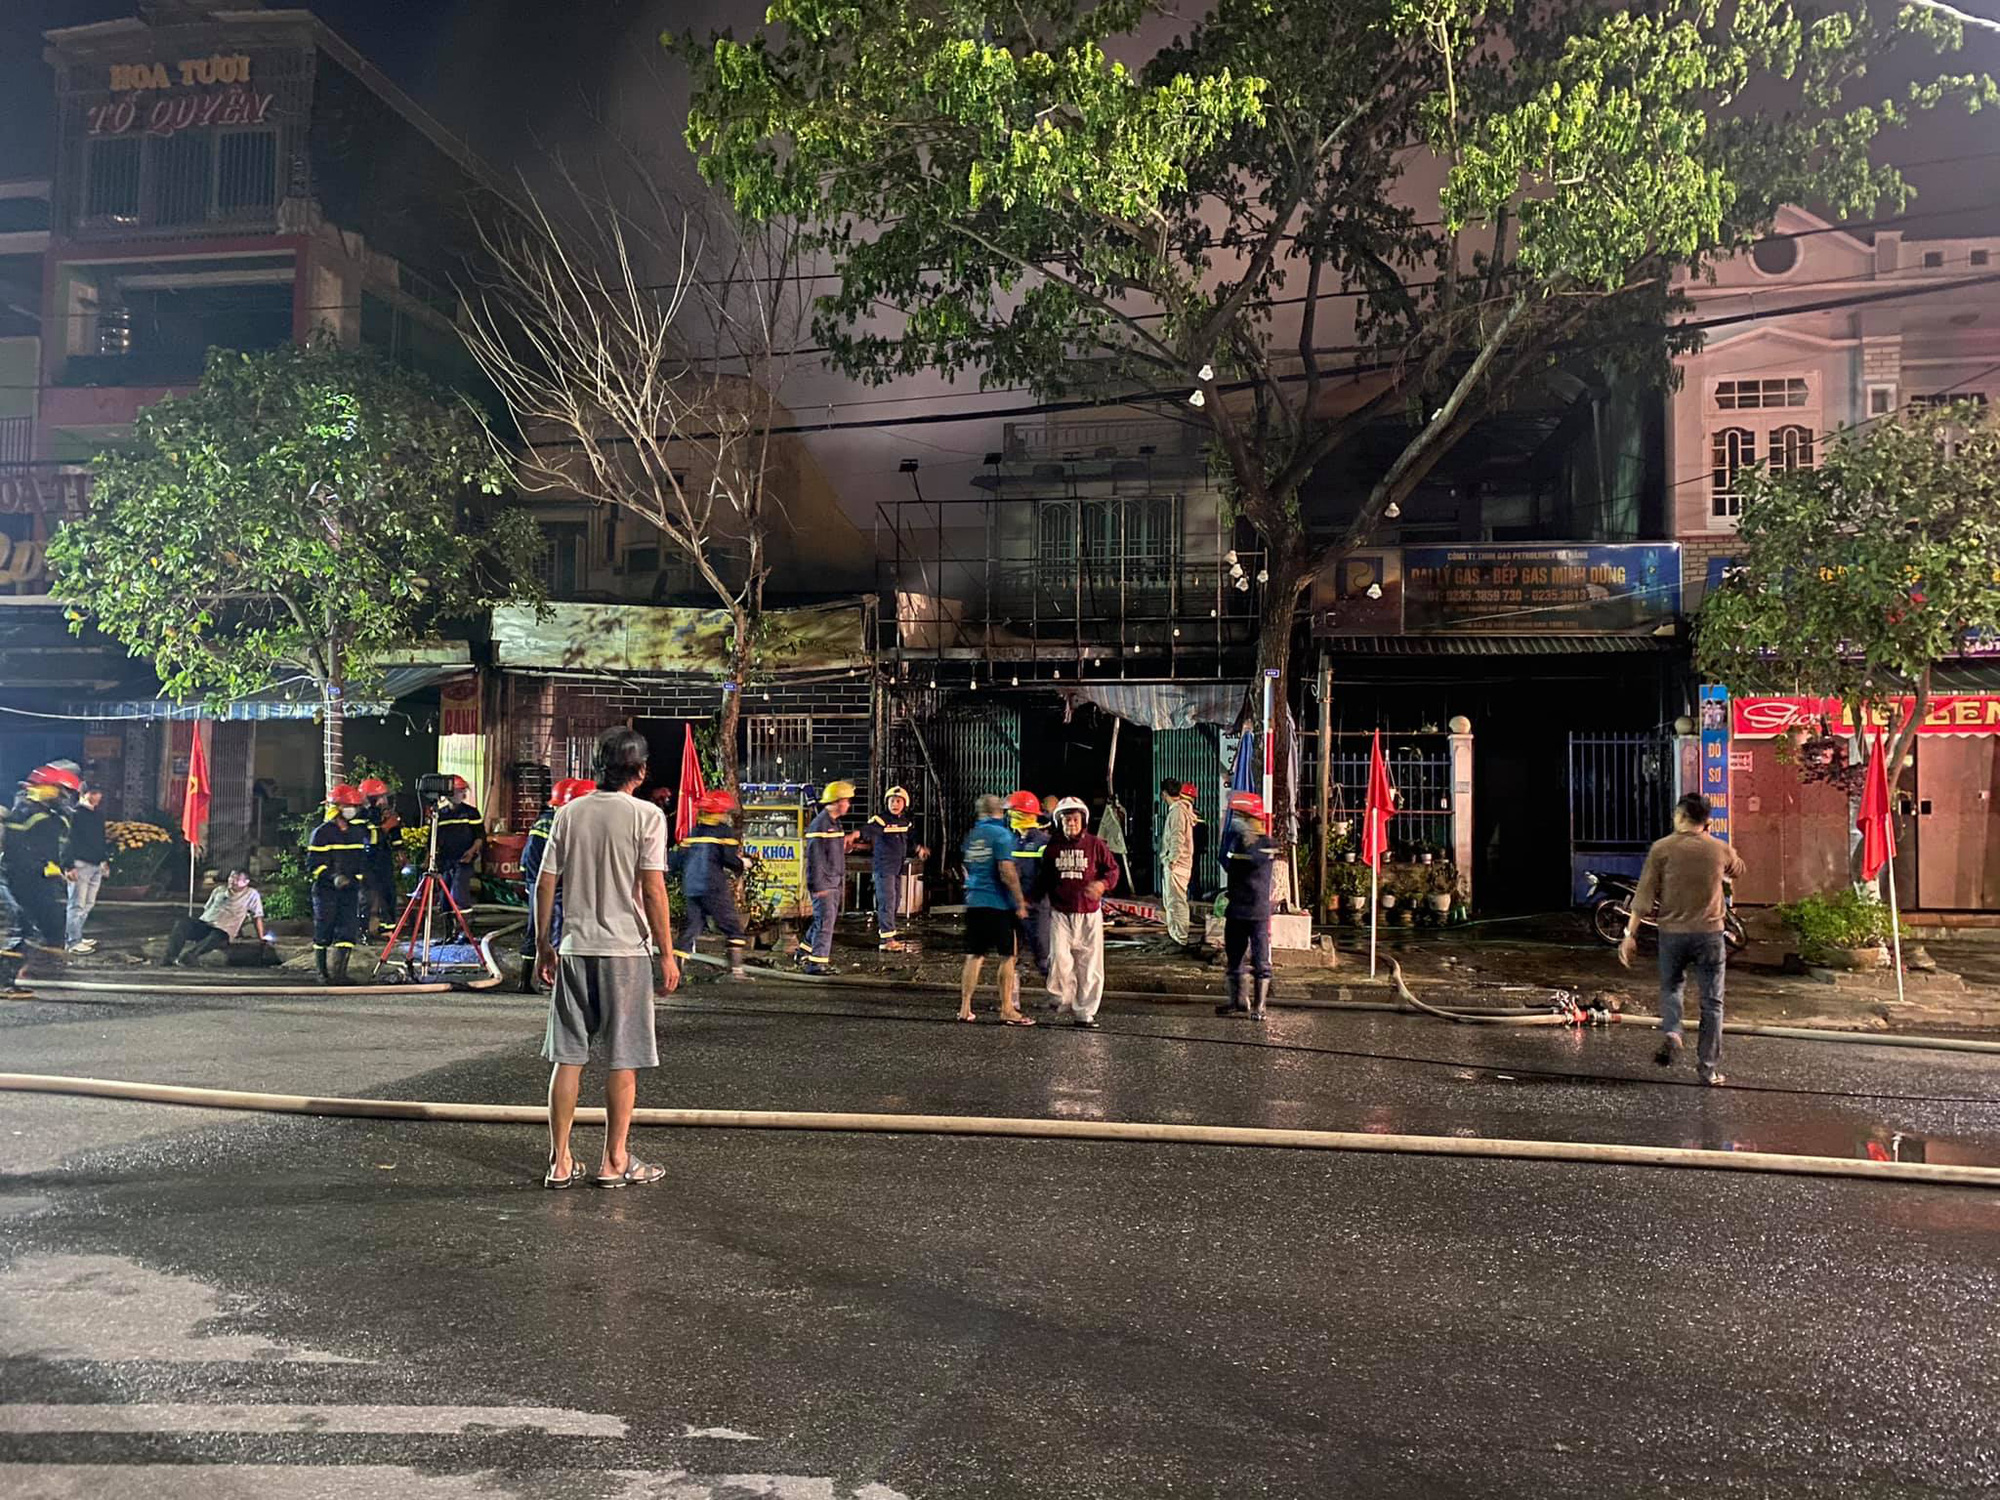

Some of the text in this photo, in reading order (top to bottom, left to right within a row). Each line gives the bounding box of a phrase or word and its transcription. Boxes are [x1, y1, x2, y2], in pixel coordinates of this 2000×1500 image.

[109, 63, 171, 91] HOA
[1497, 552, 1512, 560] GAS
[1454, 567, 1480, 585] GAS
[1492, 561, 1518, 585] BẾP
[1521, 567, 1548, 585] GAS
[1551, 566, 1587, 585] MINH
[1709, 817, 1728, 836] RỌN
[762, 843, 795, 859] KHÓA
